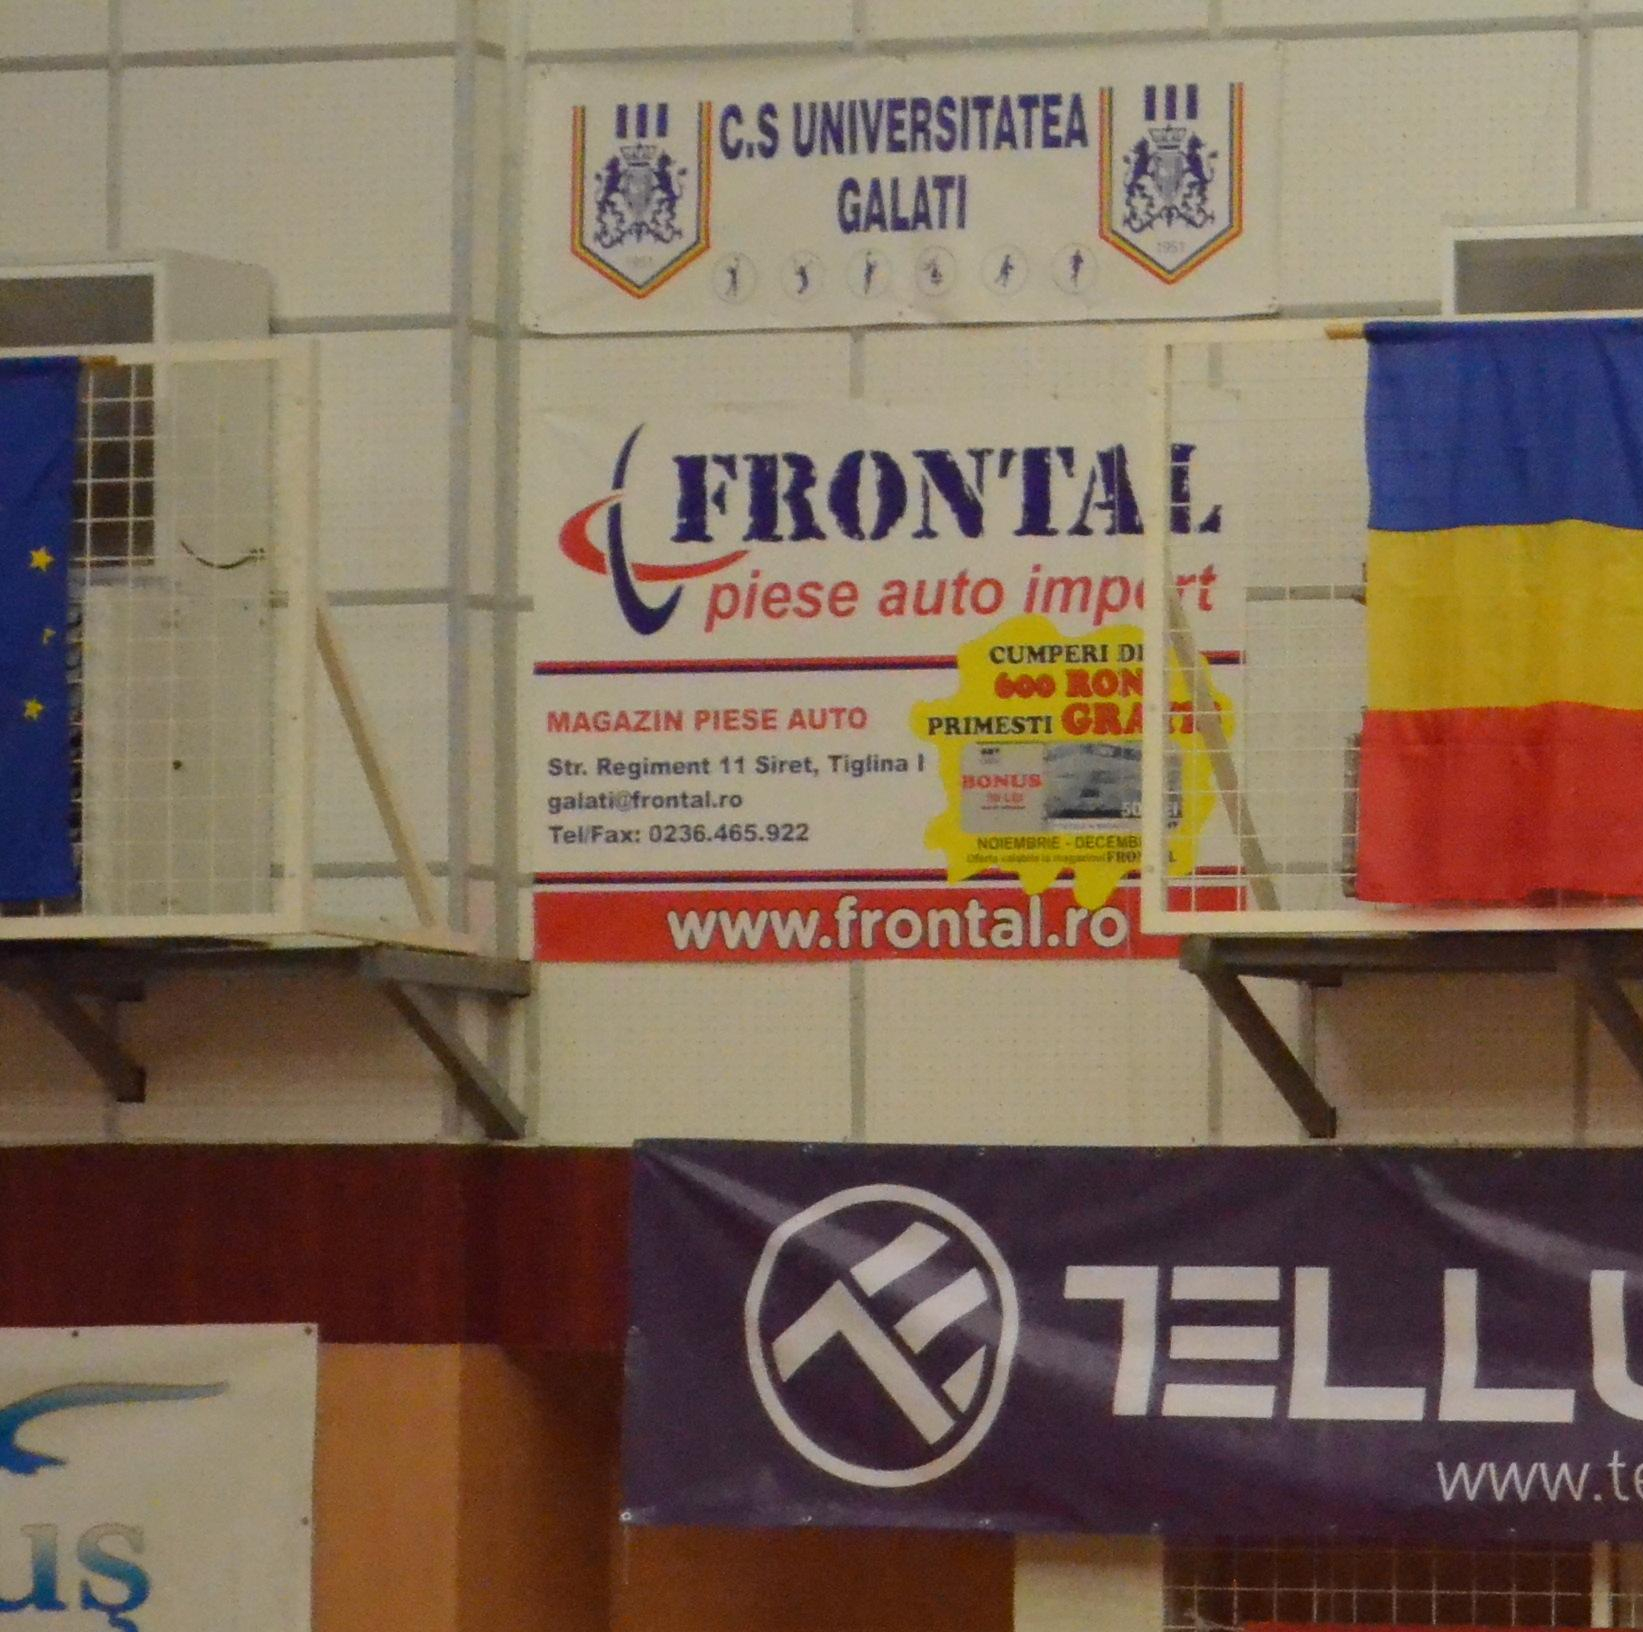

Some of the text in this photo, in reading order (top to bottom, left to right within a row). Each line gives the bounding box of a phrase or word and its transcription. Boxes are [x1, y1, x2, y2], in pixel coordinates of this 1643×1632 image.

[720, 93, 1089, 160] C.S UNIVERSITATEA
[837, 176, 967, 234] GALATI
[670, 443, 1222, 544] FRONTAL
[704, 569, 860, 633] piese
[878, 570, 1005, 620] auto
[989, 644, 1109, 664] CUMPERI
[994, 673, 1056, 699] 600
[547, 706, 868, 733] MAGAZIN PIESE AUTO
[927, 715, 1053, 736] PRIMESTI
[548, 758, 588, 776] Str.
[597, 756, 710, 780] Regiment
[720, 757, 745, 774] 11
[755, 755, 820, 777] Siret,
[828, 753, 908, 778] Tiglina
[962, 773, 1042, 789] BONUS
[548, 790, 743, 814] galati@frontal.ro
[548, 823, 810, 844] Tel/Fax: 0236.465.922
[977, 836, 1060, 849] NOIEMBRIE
[667, 897, 1127, 951] www.frontal.ro
